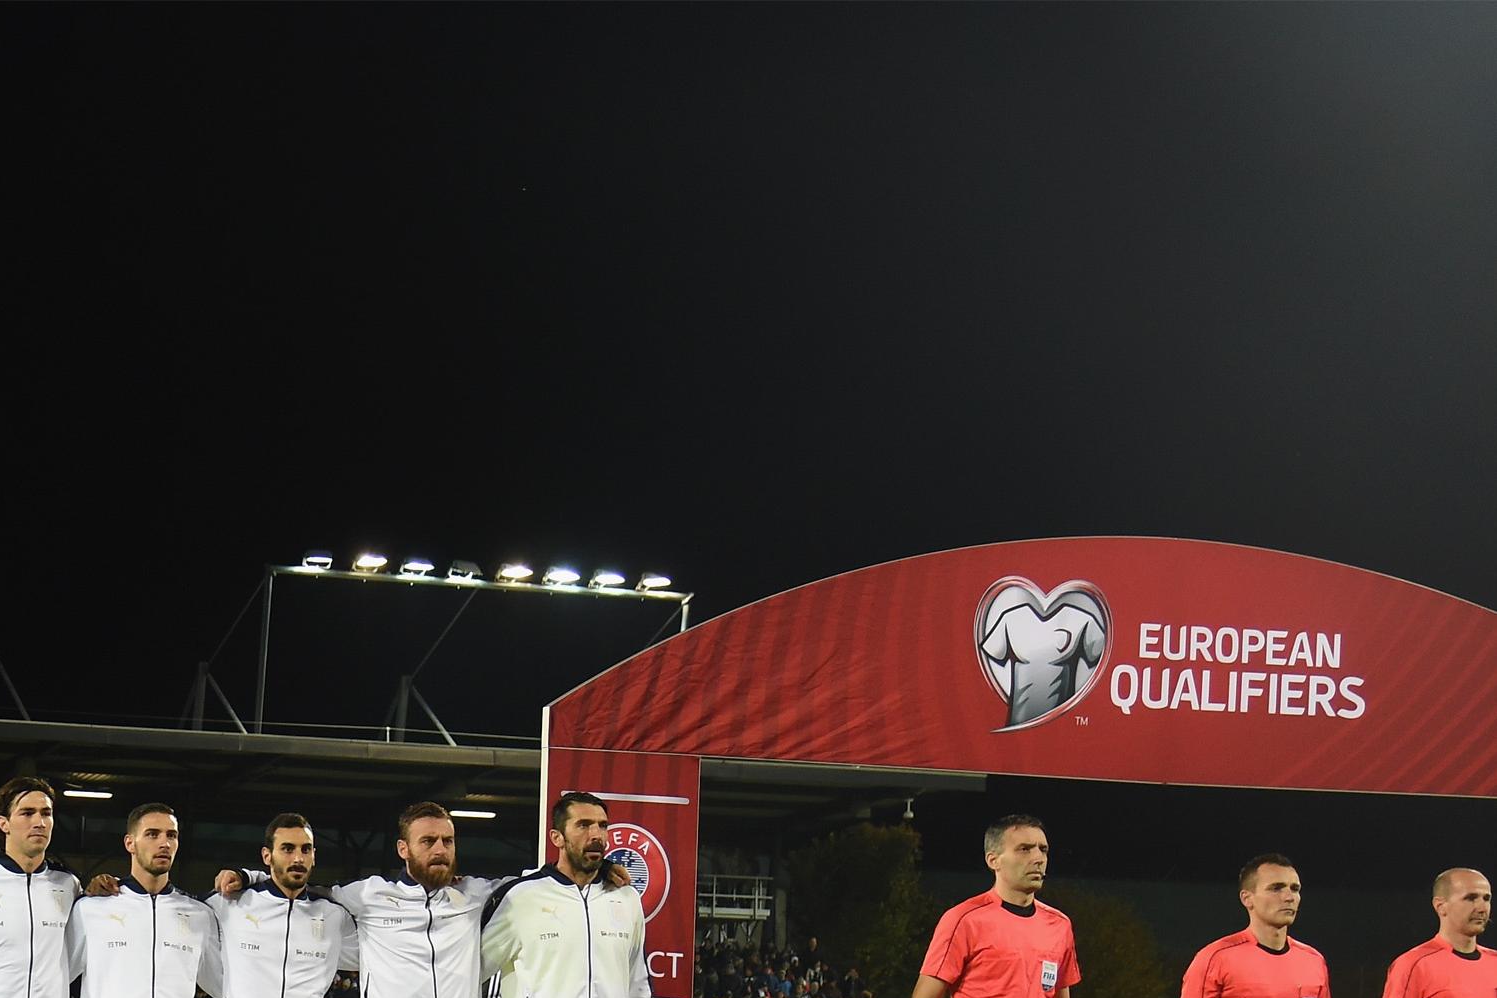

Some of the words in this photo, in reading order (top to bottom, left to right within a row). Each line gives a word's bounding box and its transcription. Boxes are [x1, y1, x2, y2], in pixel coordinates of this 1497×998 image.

[1139, 623, 1342, 669] EUROPEAN
[1110, 664, 1366, 719] QUALIFIERS
[1075, 716, 1089, 726] TM
